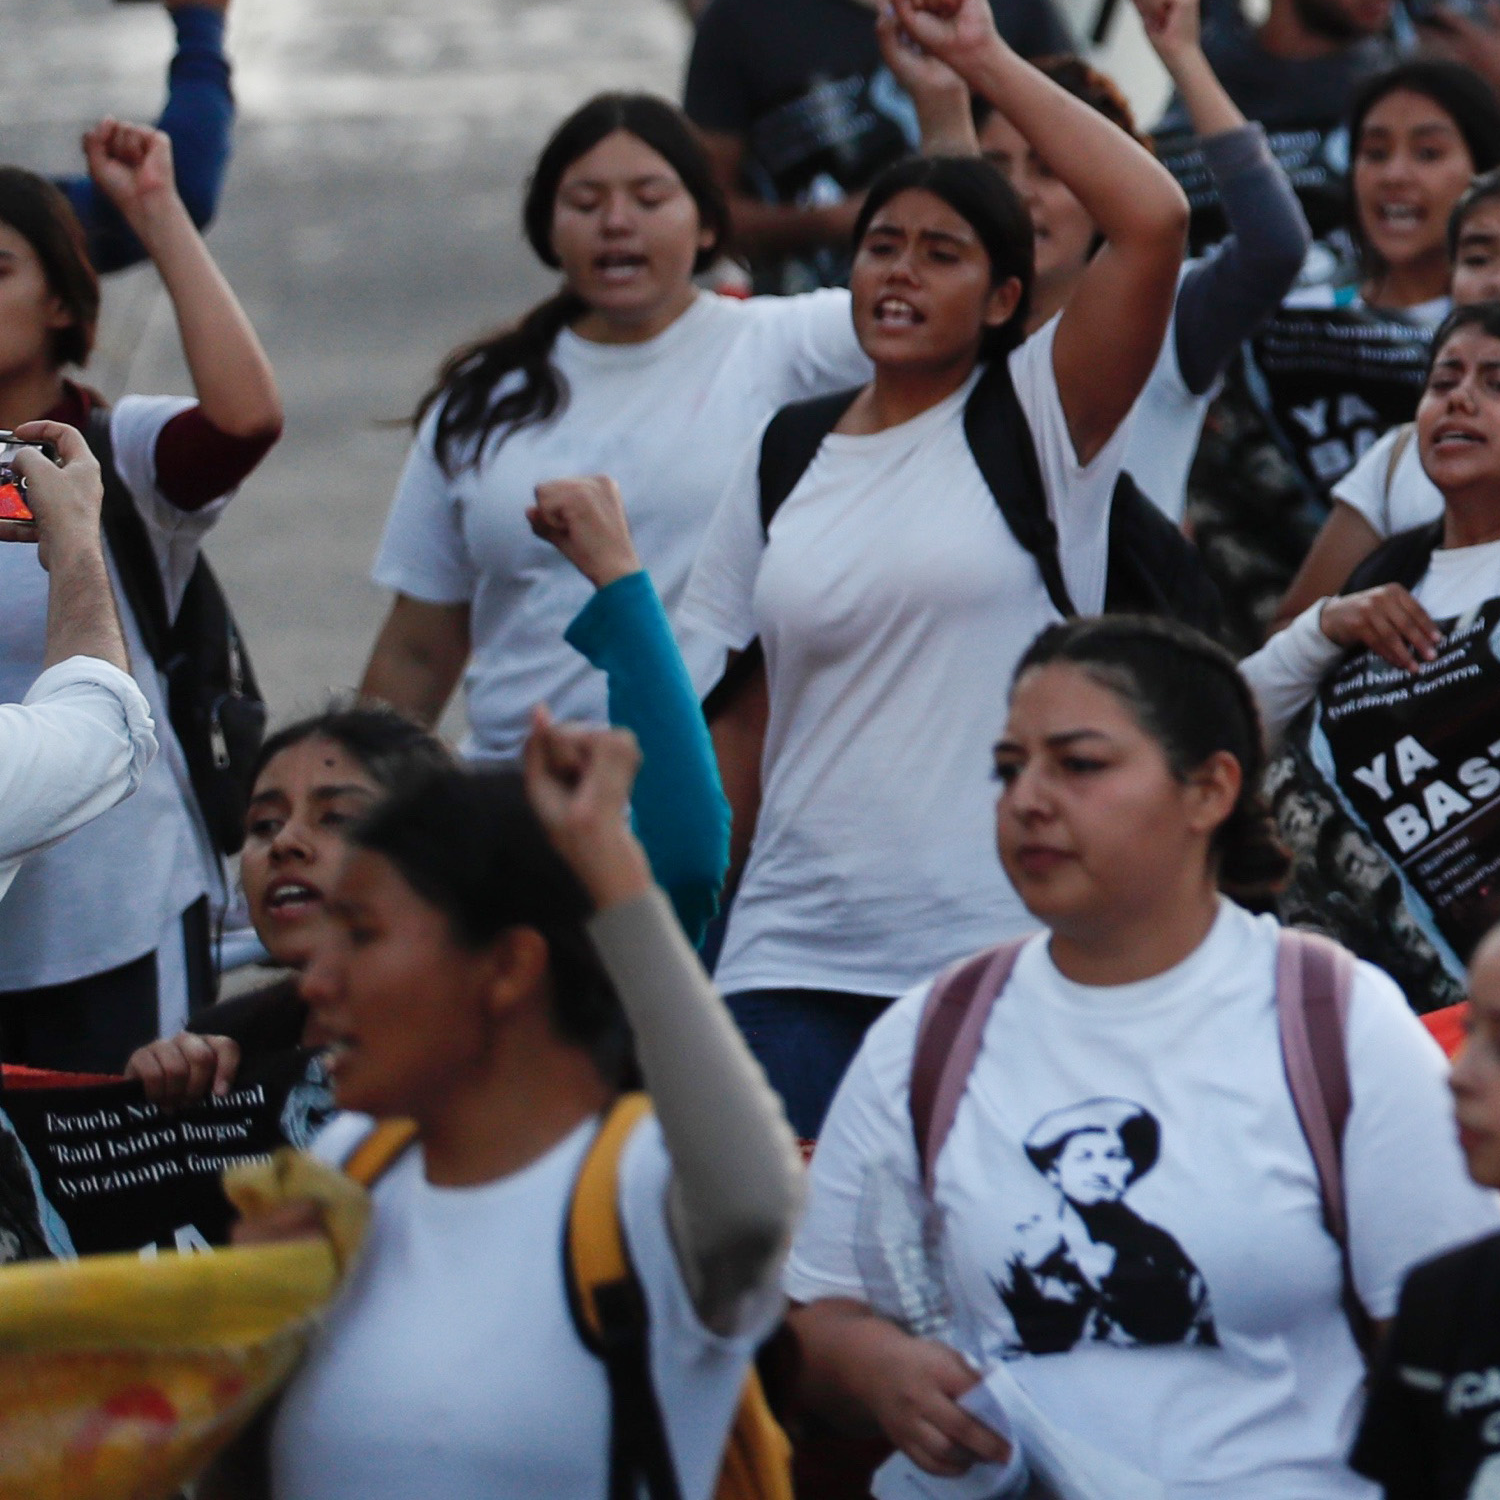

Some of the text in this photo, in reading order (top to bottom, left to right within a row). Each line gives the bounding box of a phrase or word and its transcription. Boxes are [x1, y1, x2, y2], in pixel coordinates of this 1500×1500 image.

[1352, 734, 1440, 802] YA
[46, 1109, 121, 1133] Escuela
[107, 1127, 177, 1159] Isidro
[181, 1118, 254, 1144] Burgos"
